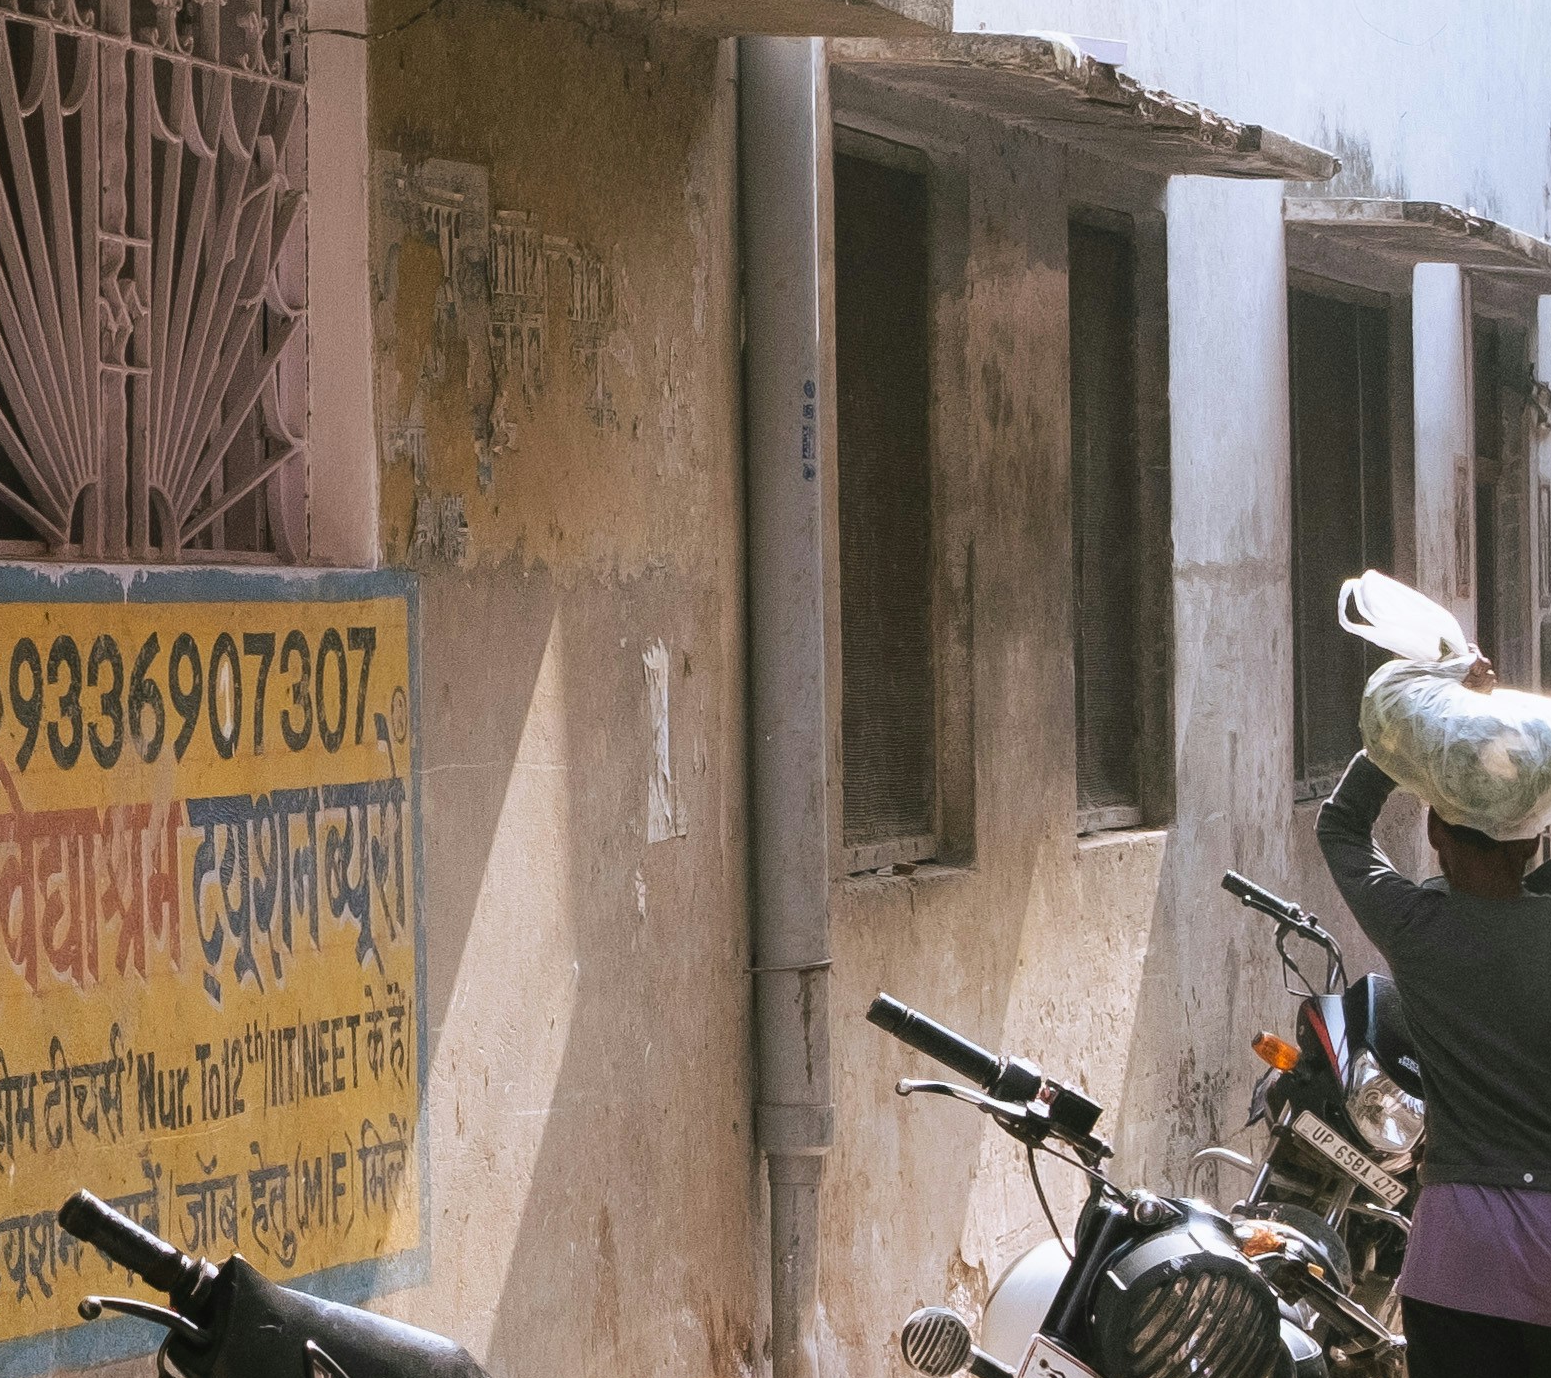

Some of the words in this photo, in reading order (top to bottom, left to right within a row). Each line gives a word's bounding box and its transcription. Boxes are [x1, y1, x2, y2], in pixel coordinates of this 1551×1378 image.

[9, 626, 377, 773] 9336907307
[137, 1051, 193, 1132] Nur.
[364, 984, 385, 1083] के
[1311, 1126, 1335, 1149] UP
